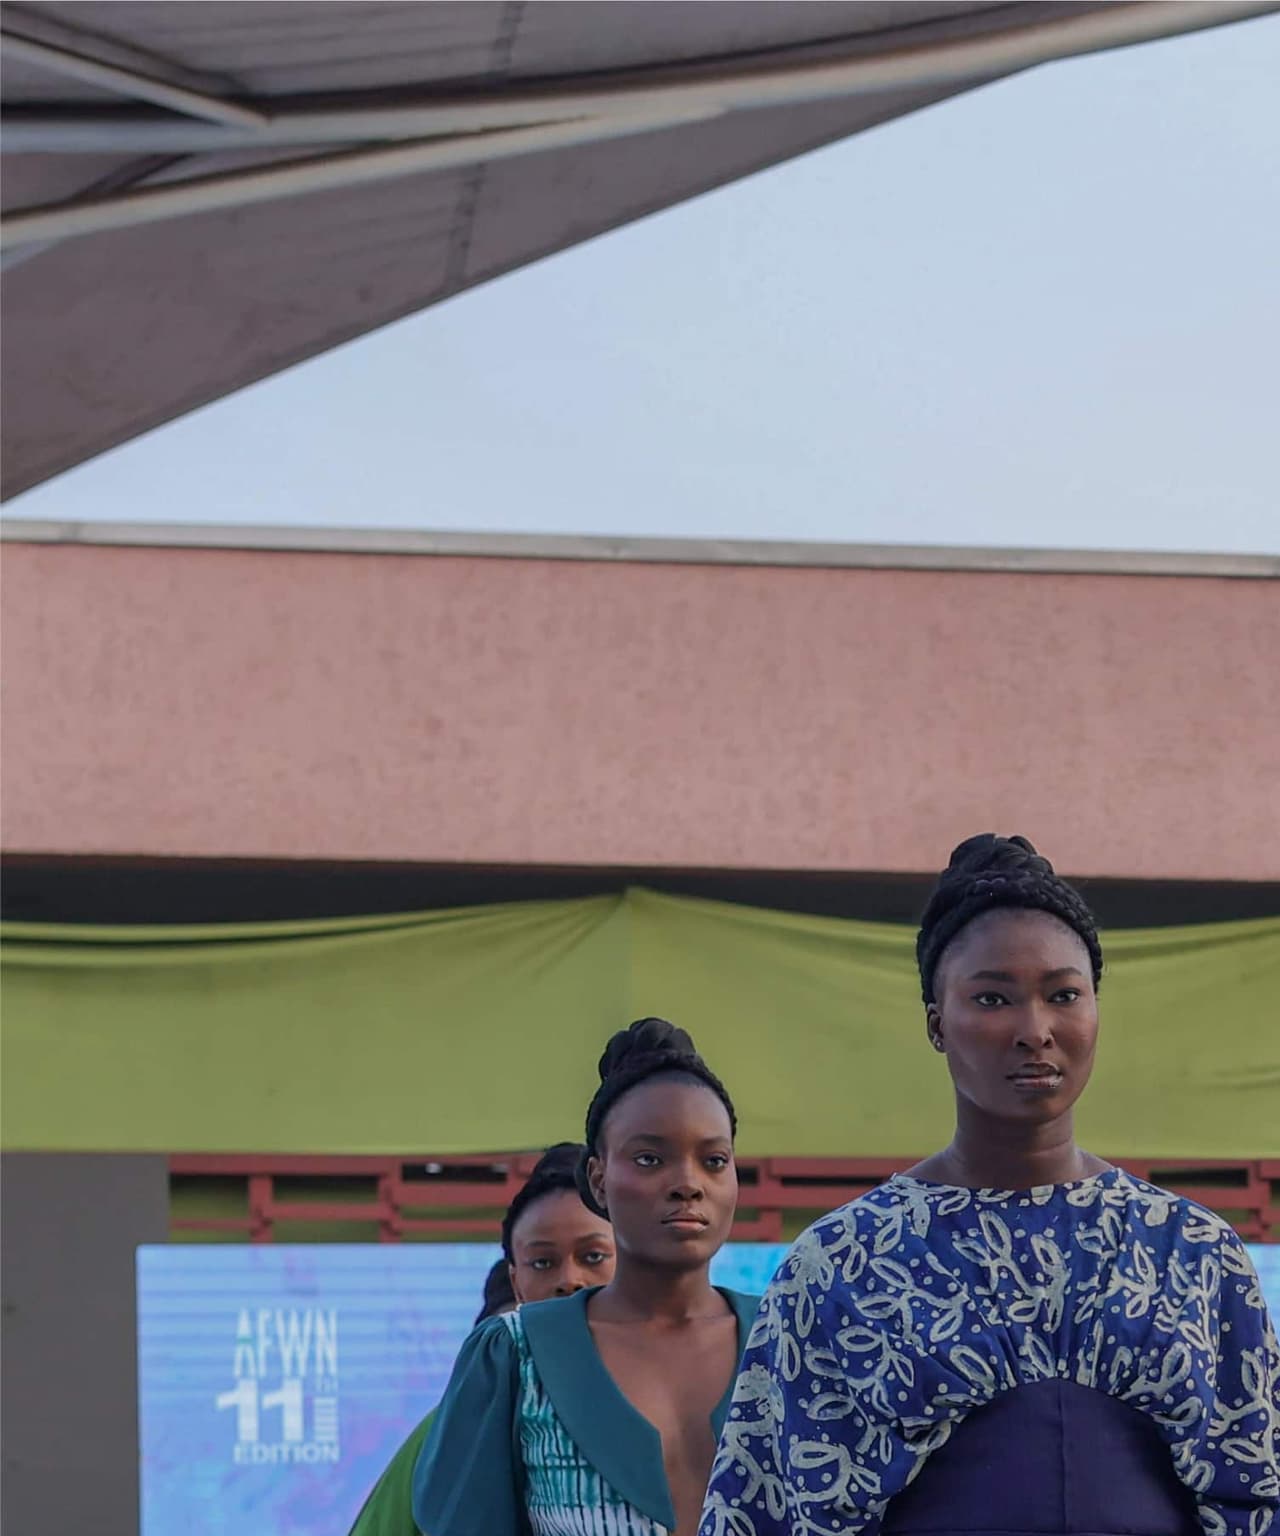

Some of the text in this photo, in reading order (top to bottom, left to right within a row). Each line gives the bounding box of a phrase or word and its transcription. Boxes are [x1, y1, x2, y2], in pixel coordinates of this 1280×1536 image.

[233, 1309, 337, 1377] AFWN
[216, 1378, 304, 1441] 11
[233, 1444, 340, 1464] EDITION
